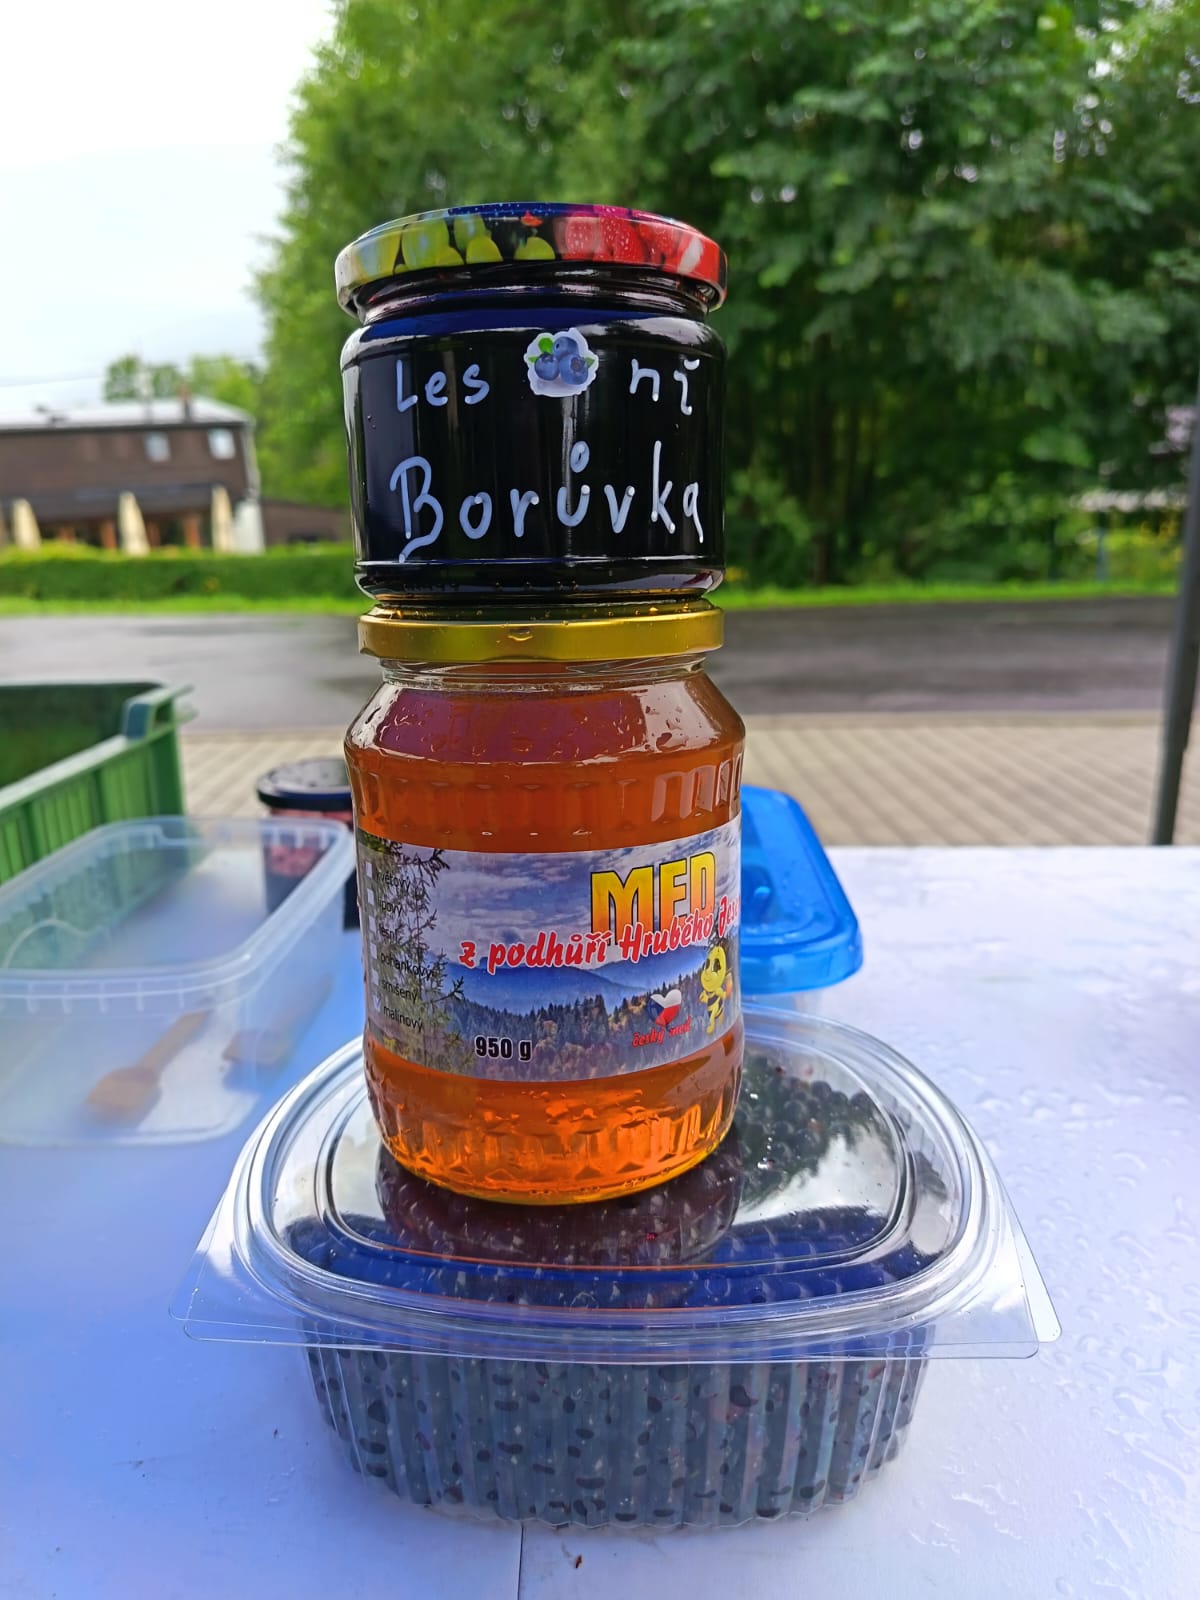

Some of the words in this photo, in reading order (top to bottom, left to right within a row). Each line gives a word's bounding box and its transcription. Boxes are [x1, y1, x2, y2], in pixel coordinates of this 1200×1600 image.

[395, 359, 490, 413] Les
[389, 440, 704, 564] Borůvka
[590, 851, 716, 946] MED
[458, 940, 476, 967] z
[487, 929, 614, 975] podhůří
[618, 907, 714, 964] Hrubého
[475, 1035, 513, 1060] 950
[519, 1039, 532, 1062] g
[631, 1027, 665, 1048] český
